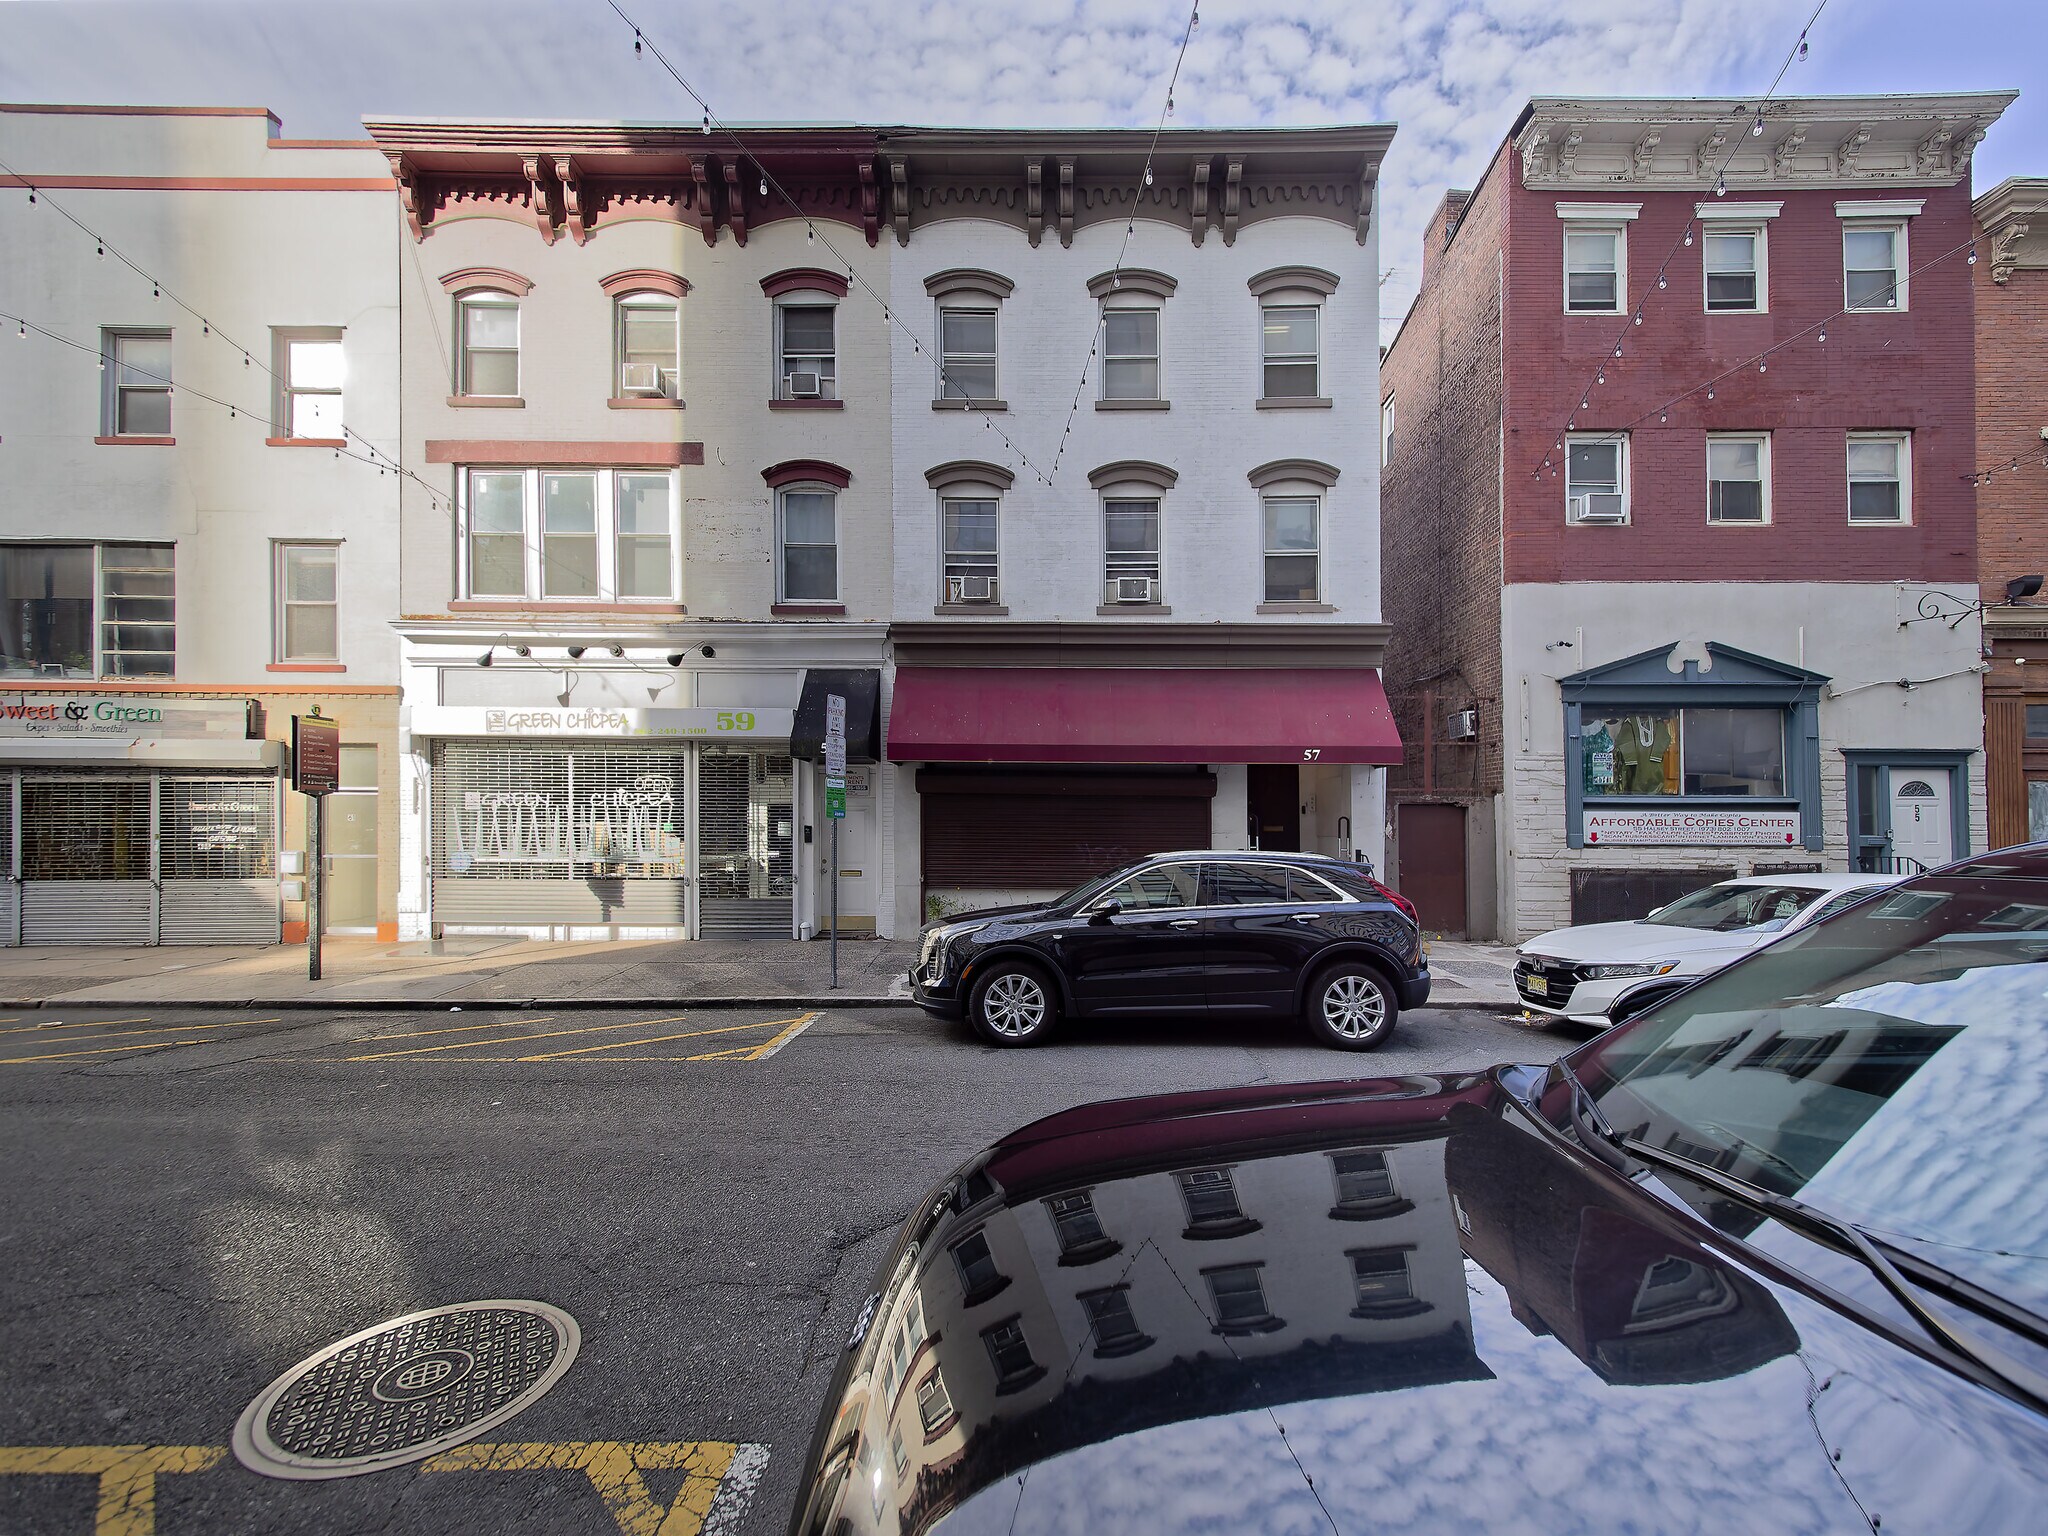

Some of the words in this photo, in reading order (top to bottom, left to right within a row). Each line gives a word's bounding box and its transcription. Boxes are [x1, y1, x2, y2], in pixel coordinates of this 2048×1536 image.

[832, 698, 839, 707] NO
[65, 701, 89, 720] &
[94, 701, 163, 722] Green
[828, 707, 844, 717] PARKING
[507, 713, 561, 732] GREEN
[567, 708, 629, 729] CHICPEA
[716, 712, 755, 731] 59
[57, 723, 83, 732] Salads
[90, 723, 128, 733] Smoothies
[820, 743, 827, 754] 5
[1303, 749, 1321, 761] 57
[1589, 817, 1680, 827] AFFORDABLE
[1684, 817, 1735, 827] COPIES
[1738, 817, 1794, 827] CENTER
